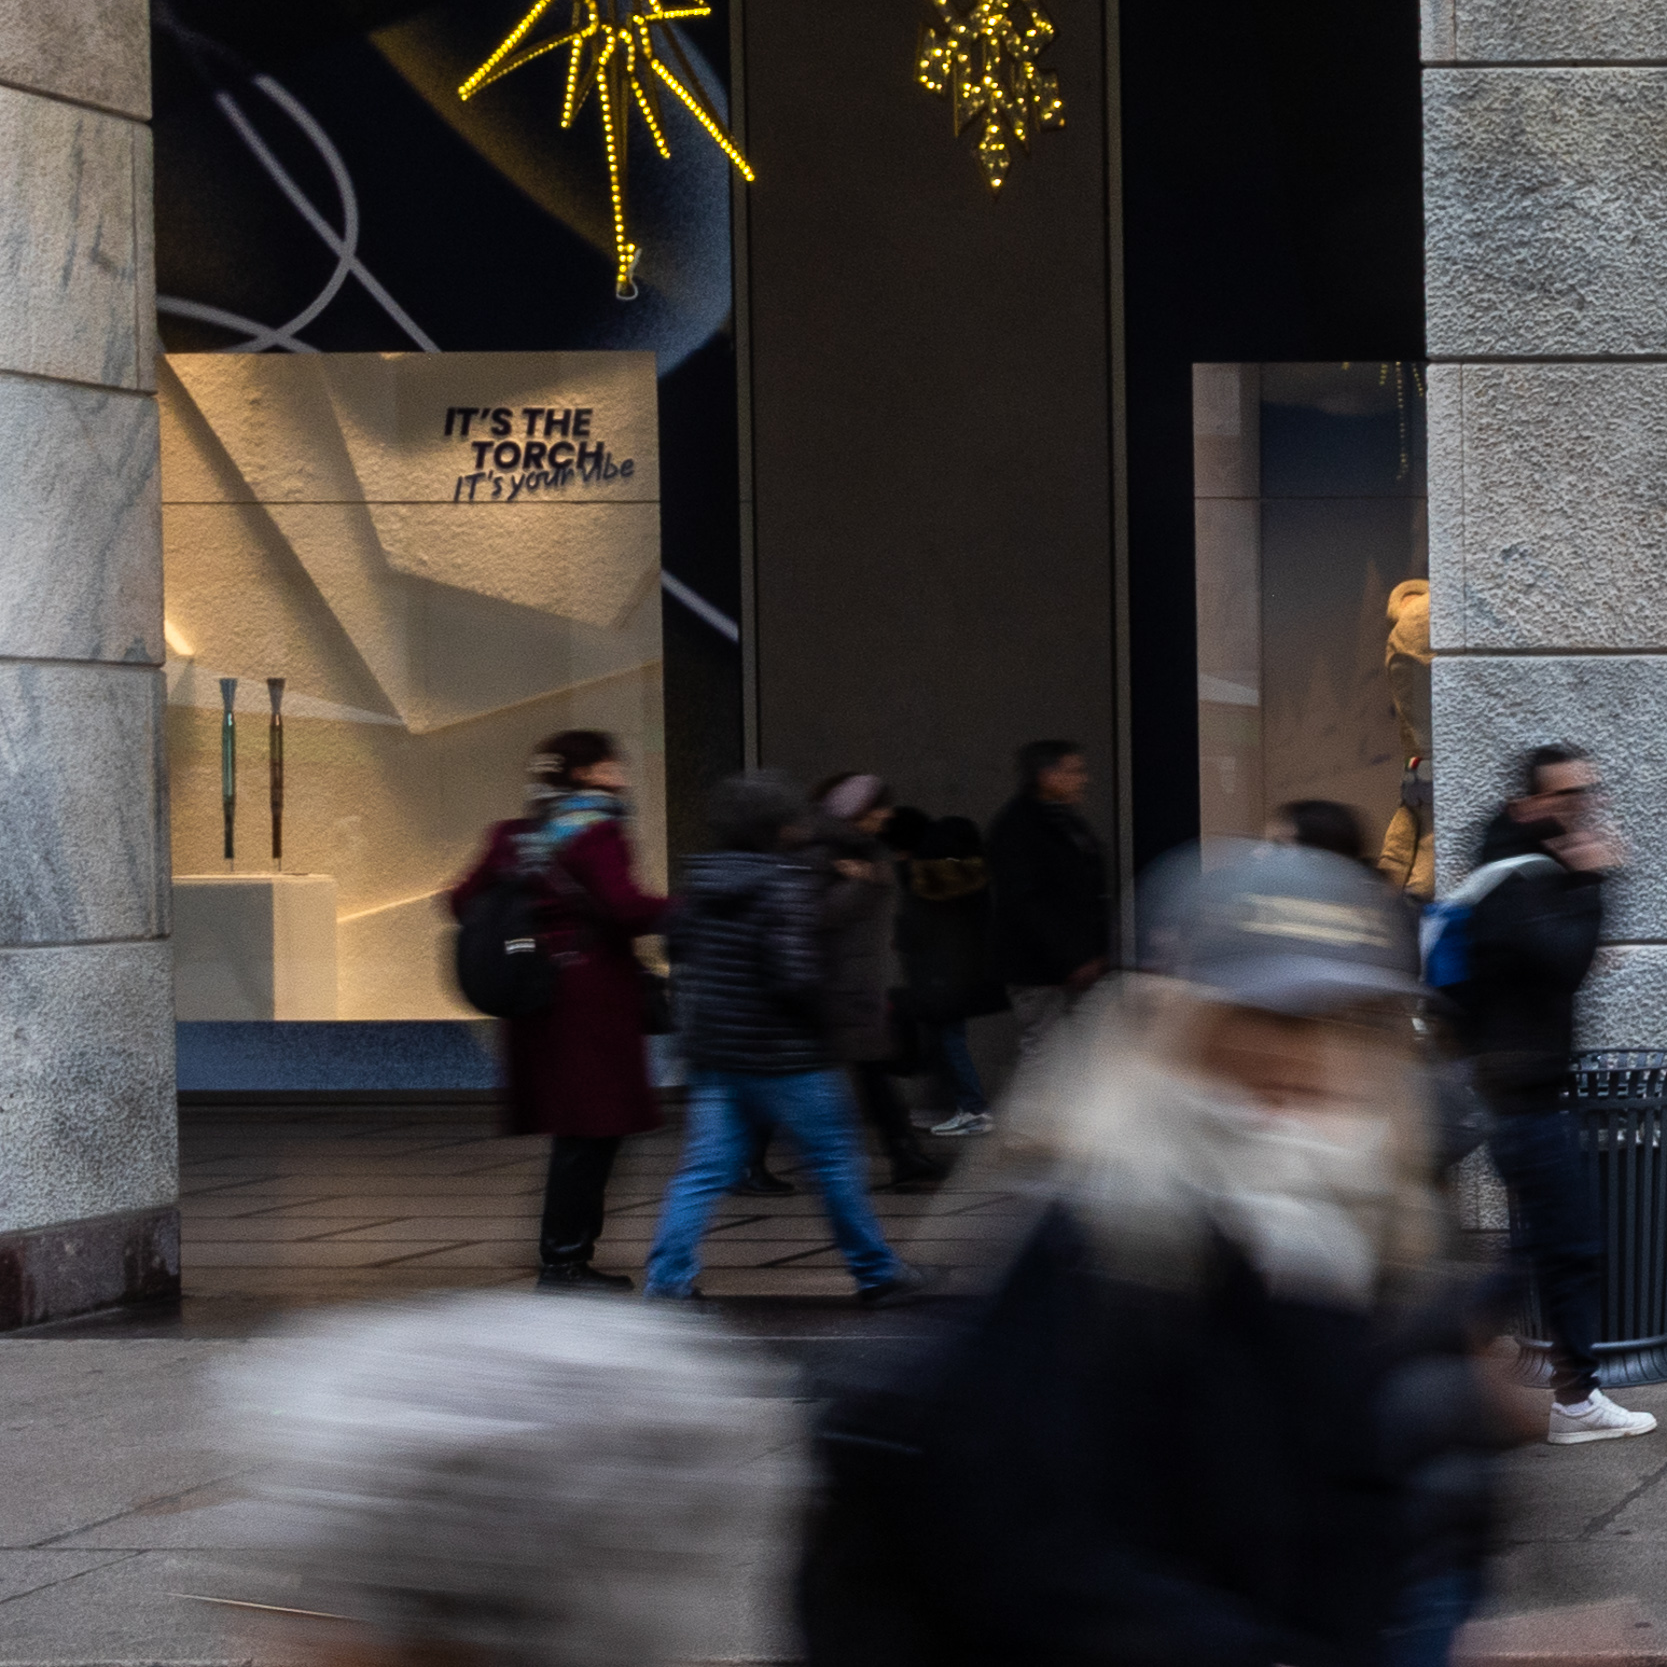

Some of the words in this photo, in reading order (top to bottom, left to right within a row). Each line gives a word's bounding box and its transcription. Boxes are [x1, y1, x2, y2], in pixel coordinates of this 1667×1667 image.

[444, 407, 514, 437] IT'S
[522, 407, 593, 437] THE
[471, 440, 605, 470] TORCH
[507, 466, 576, 502] your
